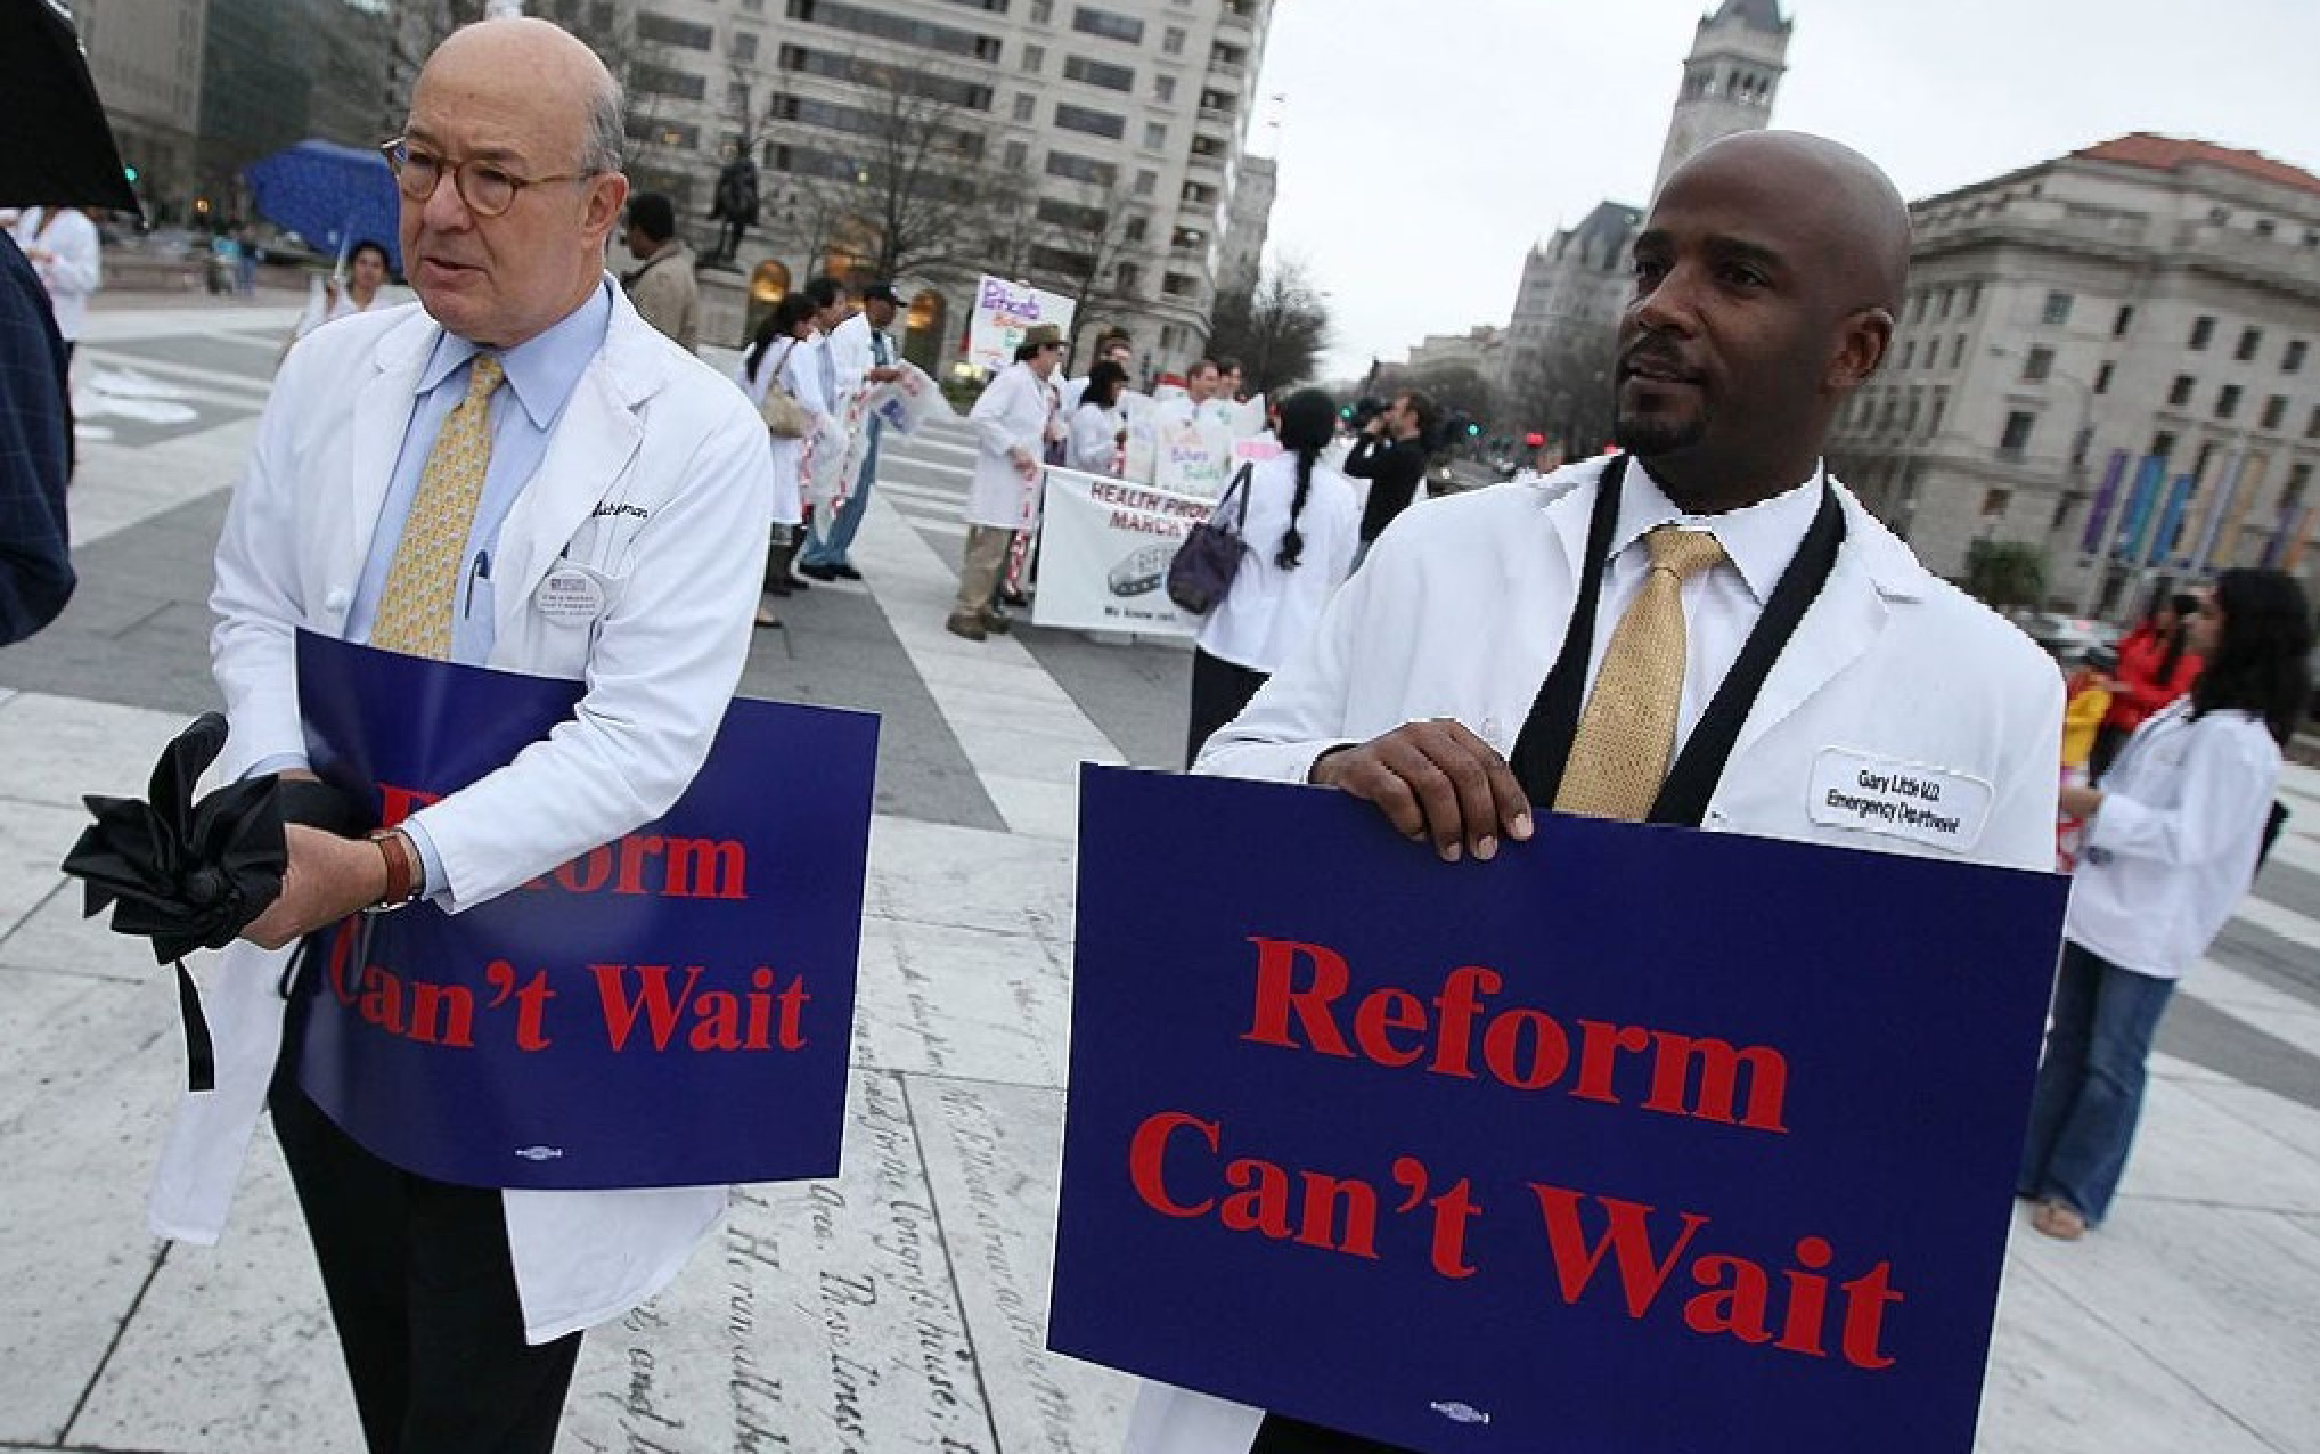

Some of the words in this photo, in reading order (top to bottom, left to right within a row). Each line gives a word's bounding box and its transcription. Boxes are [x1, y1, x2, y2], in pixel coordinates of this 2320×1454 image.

[1091, 480, 1162, 511] HEALTH
[1826, 788, 1899, 824] Emergency
[328, 914, 556, 1053] Can't
[588, 962, 812, 1053] Wait
[1241, 934, 1791, 1137] Reform
[1128, 1111, 1483, 1280] Can't
[1529, 1181, 1905, 1370] Wait
